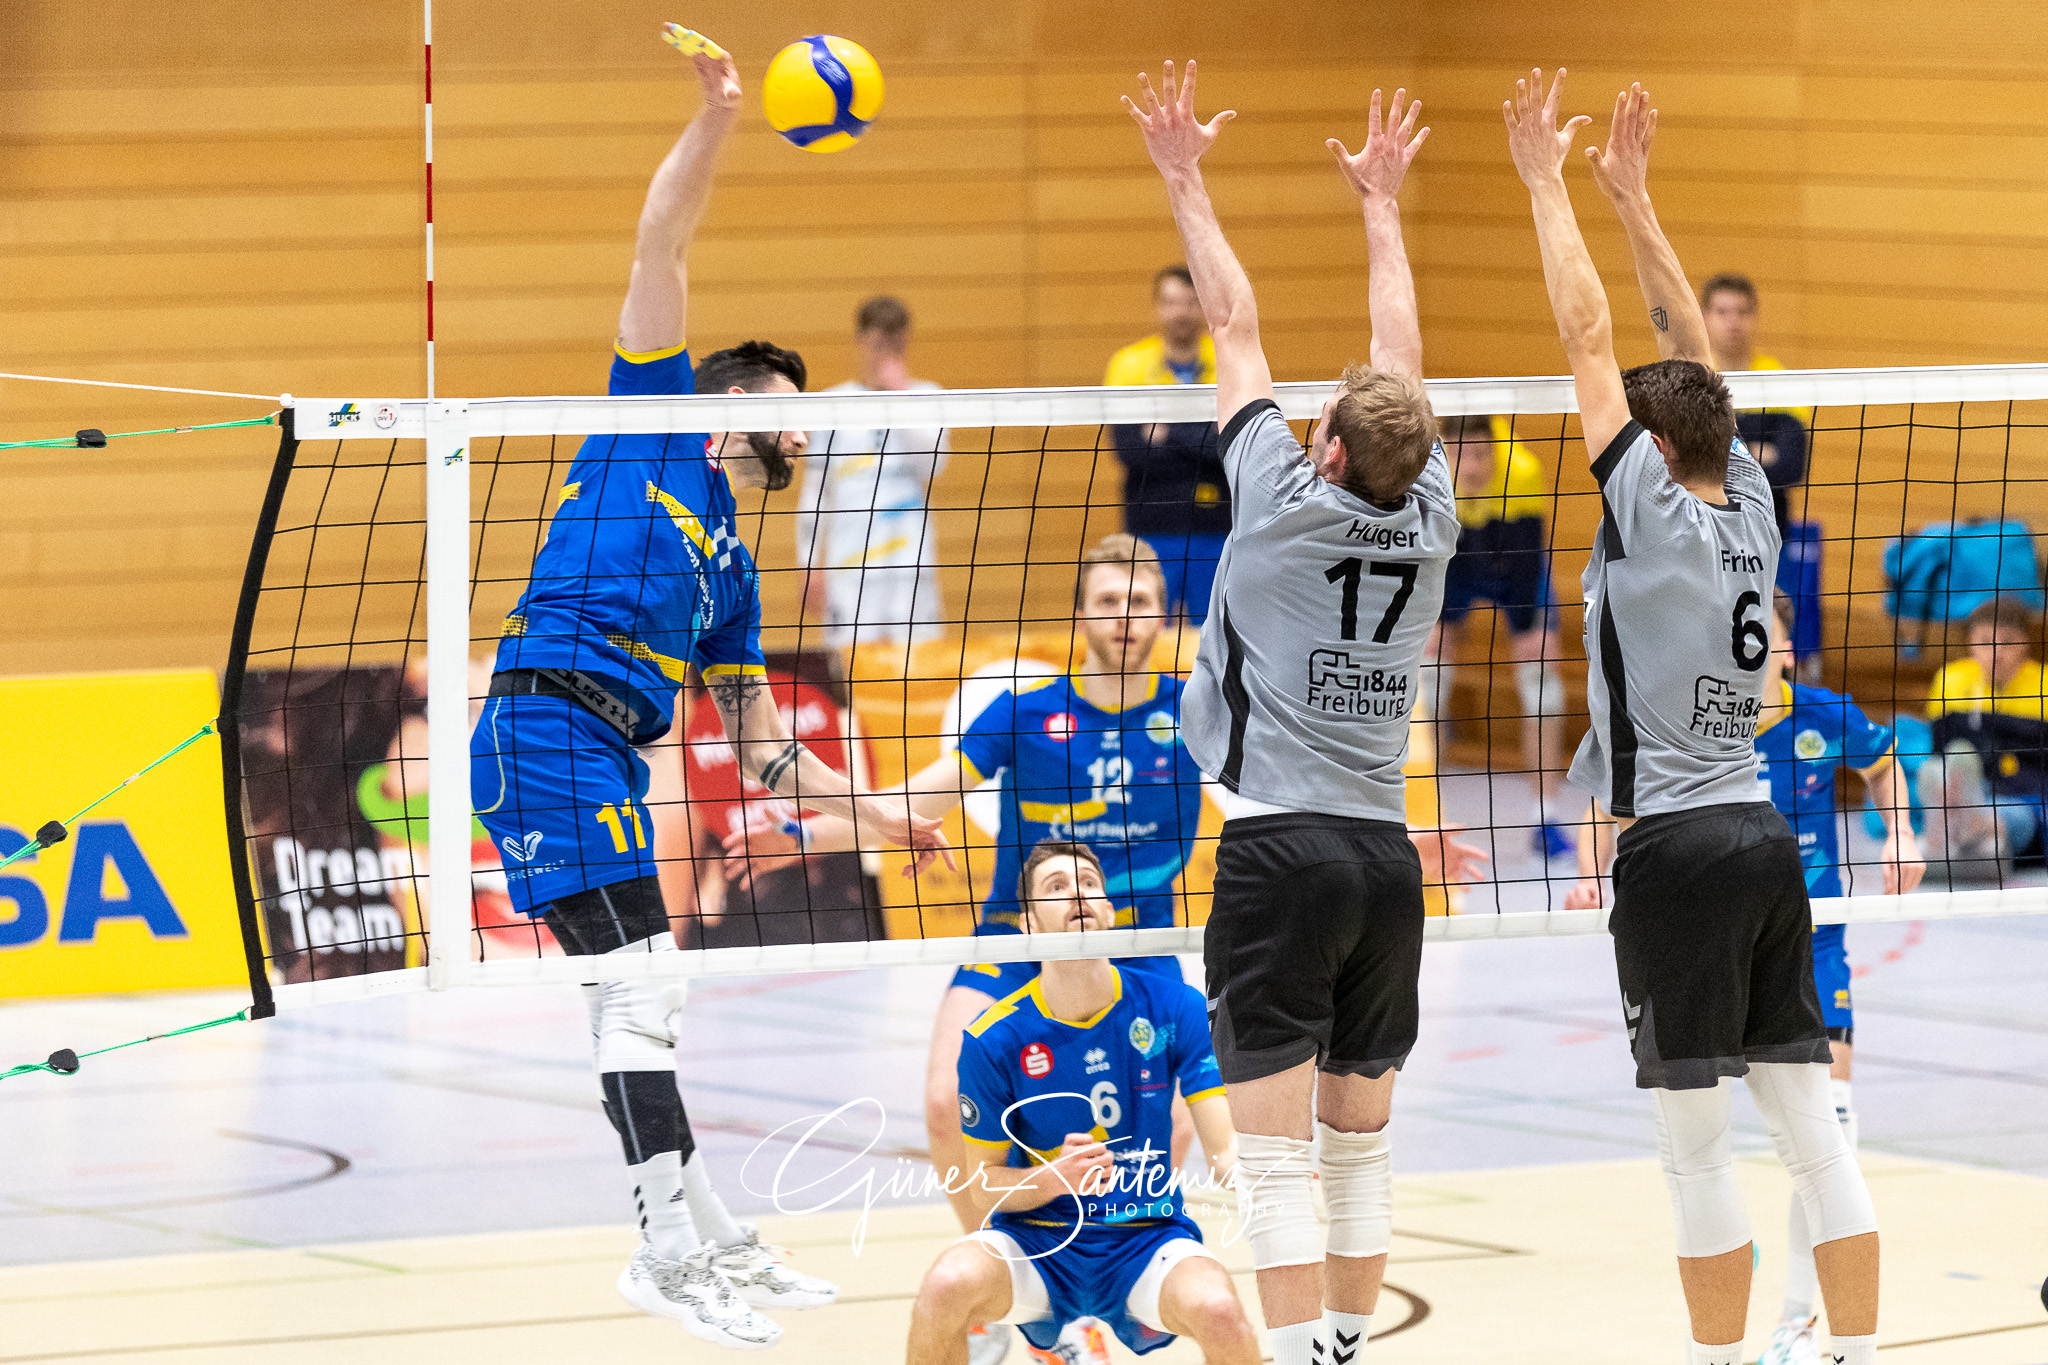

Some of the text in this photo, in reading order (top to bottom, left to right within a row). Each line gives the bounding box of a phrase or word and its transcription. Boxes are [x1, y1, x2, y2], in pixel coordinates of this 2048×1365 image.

[328, 412, 360, 423] HUCK
[1345, 519, 1419, 550] Hüger
[1324, 556, 1419, 644] 17
[1732, 590, 1769, 672] 6
[1307, 686, 1406, 720] Freiburg
[1363, 669, 1407, 697] 1844
[1087, 756, 1133, 804] 12
[595, 798, 647, 853] 11
[272, 836, 424, 897] Dream
[279, 895, 406, 955] Team
[1090, 1081, 1122, 1128] 6
